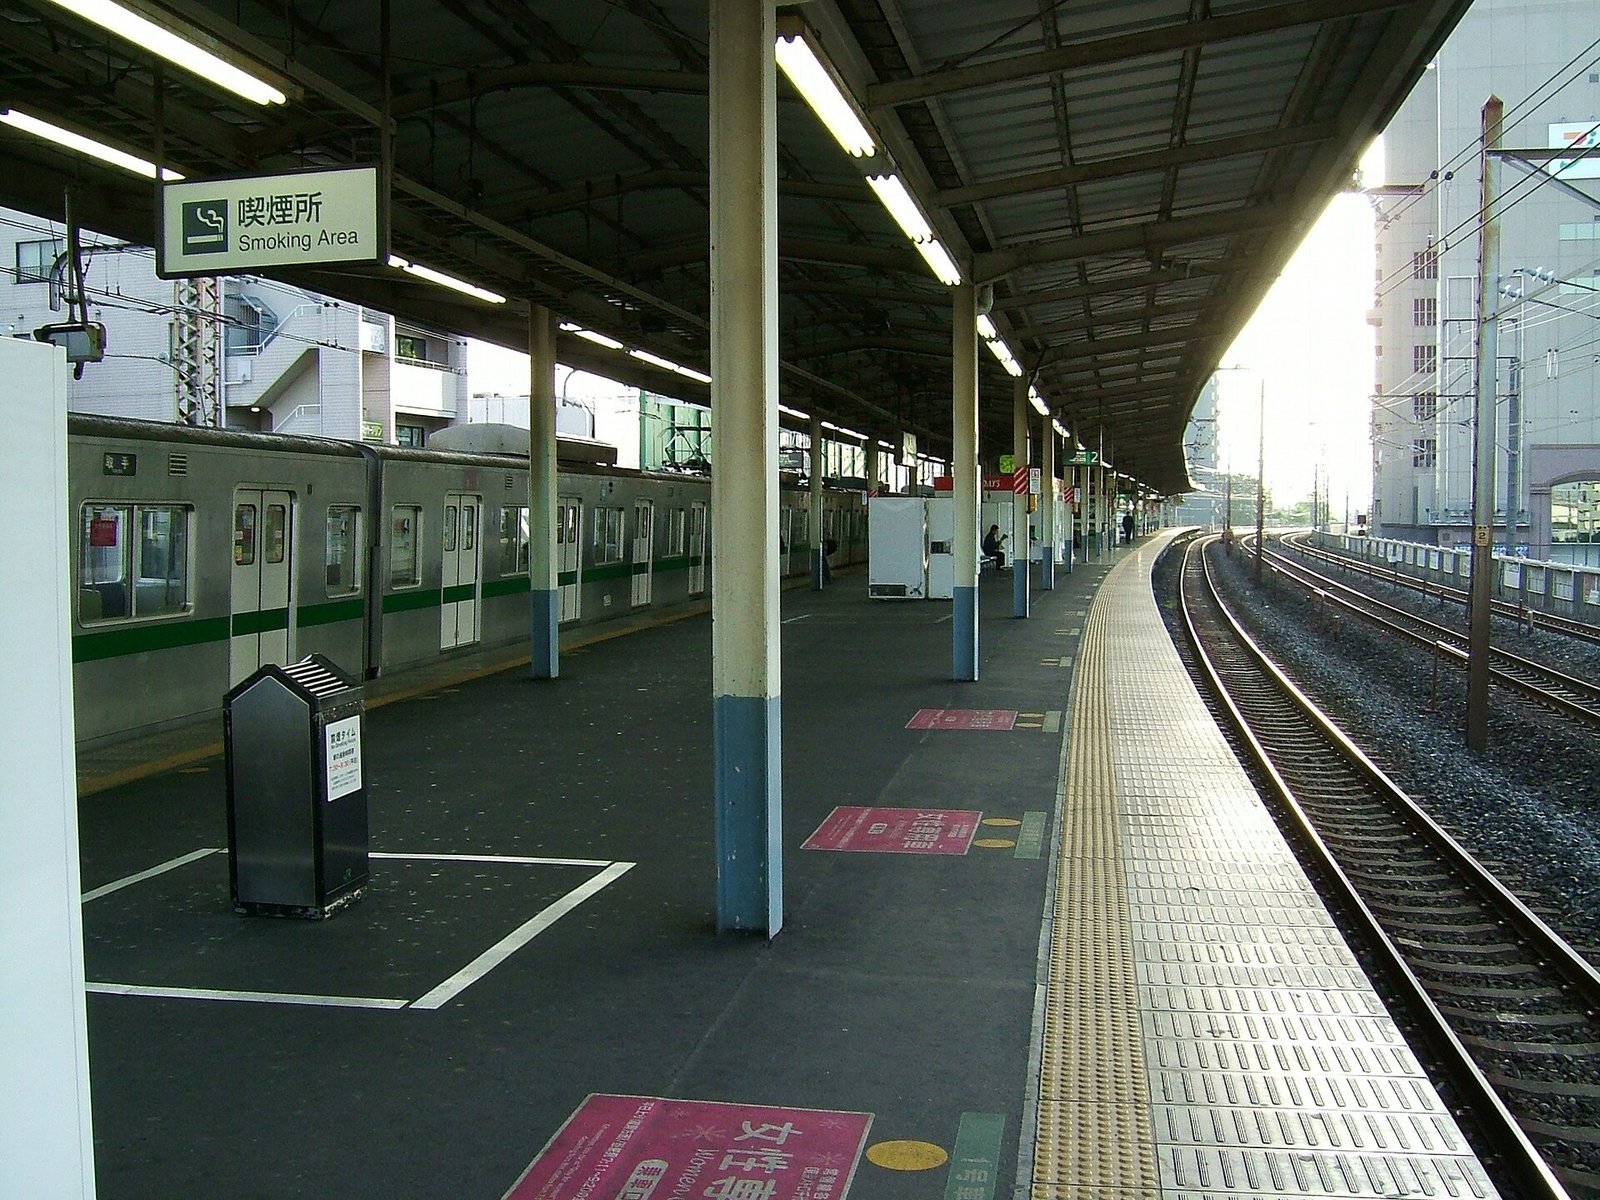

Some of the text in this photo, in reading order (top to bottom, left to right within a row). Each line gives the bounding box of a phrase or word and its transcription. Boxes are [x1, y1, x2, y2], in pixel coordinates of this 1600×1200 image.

[238, 191, 323, 228] 喫煙所
[238, 229, 358, 252] Smoking Area
[1090, 451, 1099, 463] 2
[1478, 532, 1486, 540] 2
[673, 1148, 720, 1195] Women
[703, 1120, 804, 1200] 女性専
